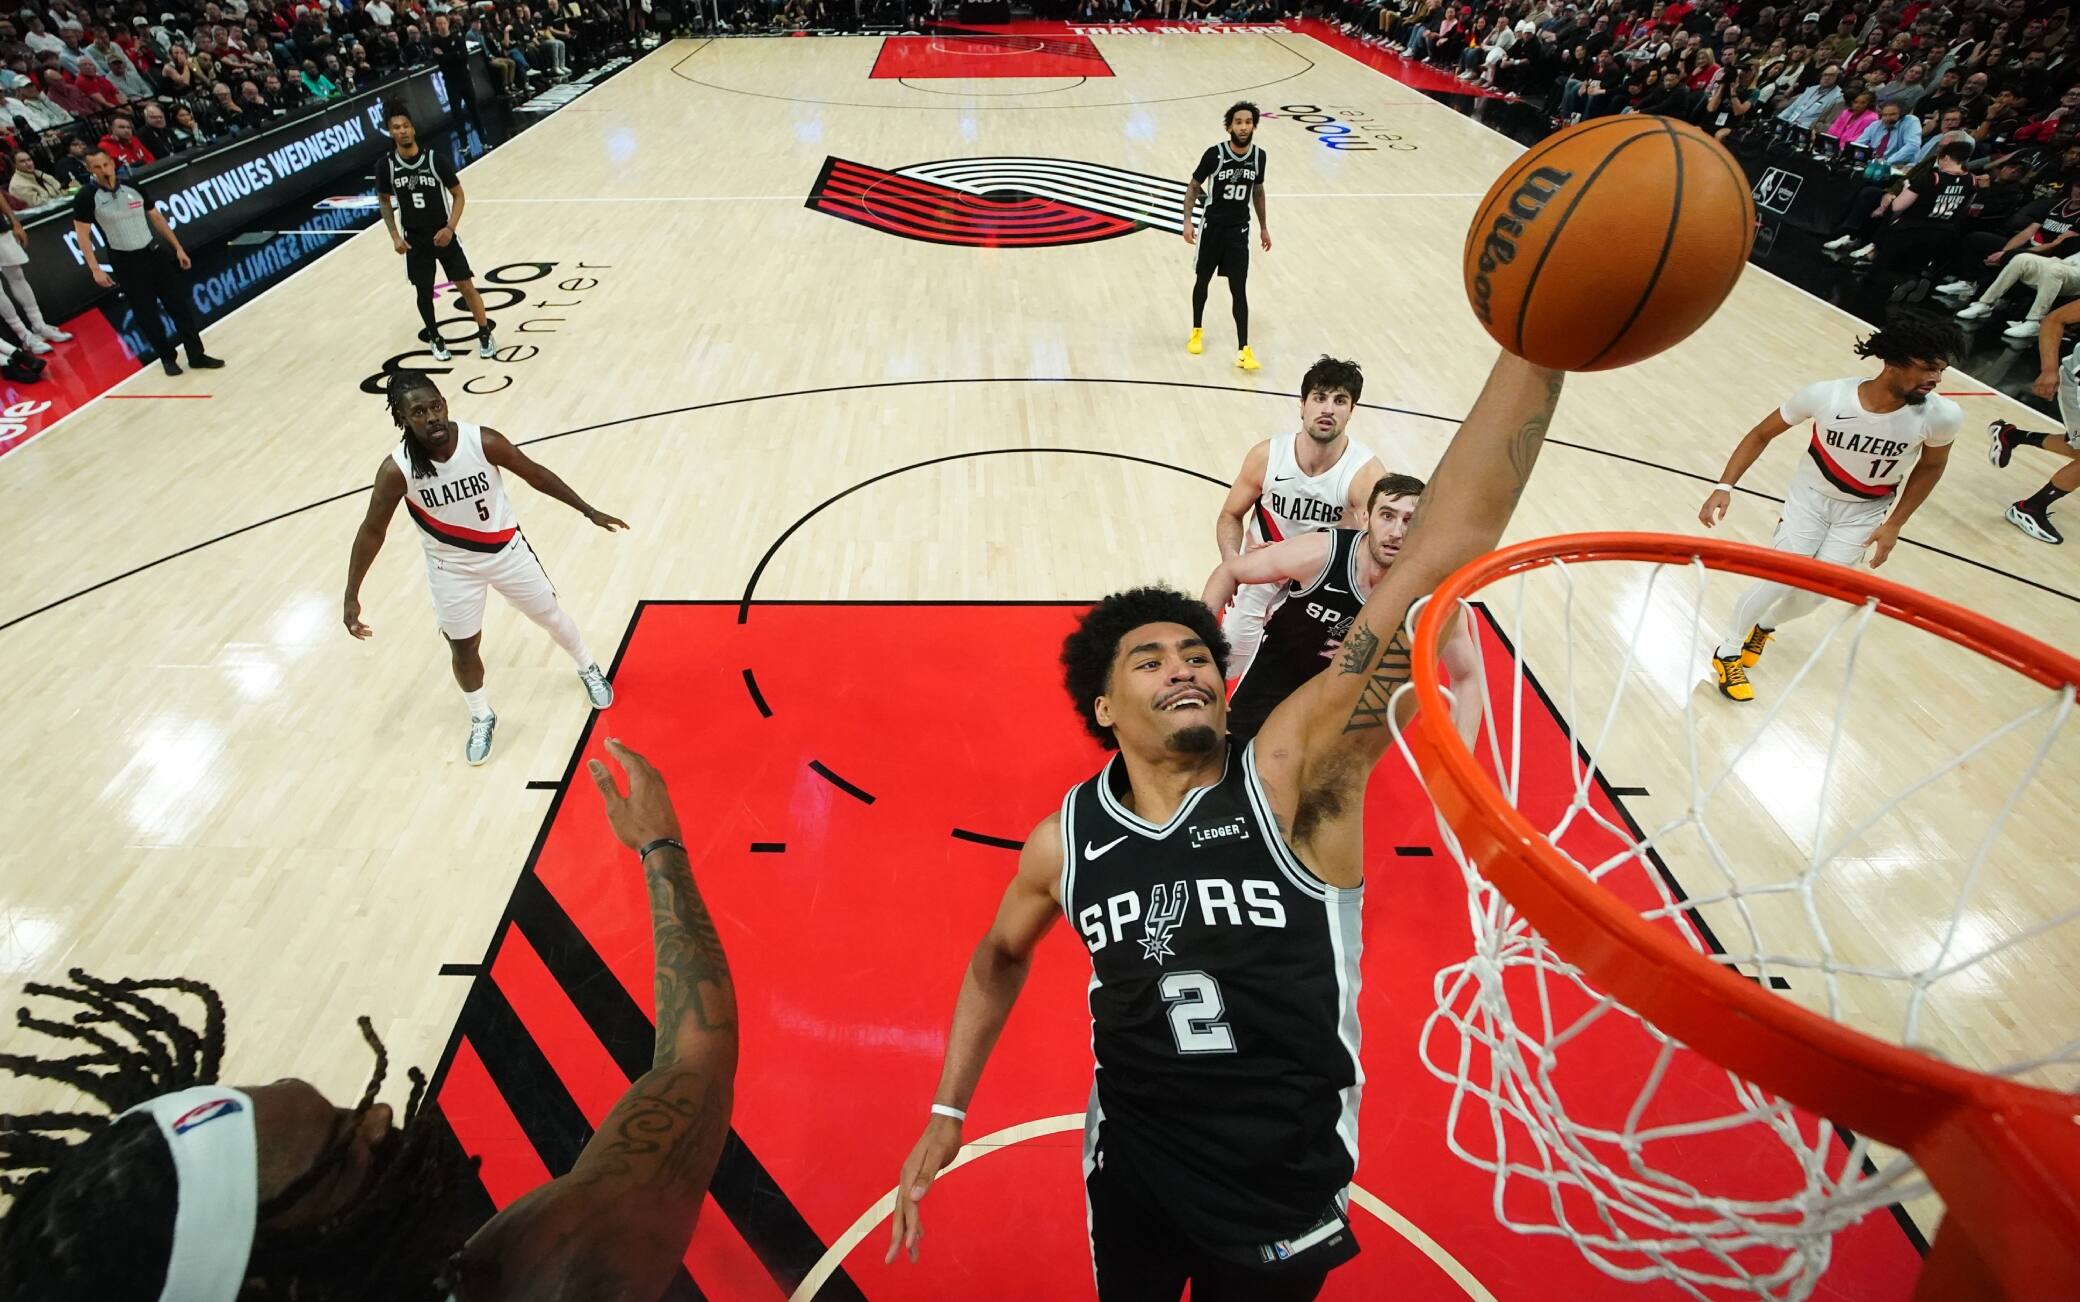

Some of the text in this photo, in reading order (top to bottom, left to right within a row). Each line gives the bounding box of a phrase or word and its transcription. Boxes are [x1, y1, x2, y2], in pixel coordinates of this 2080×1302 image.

[1066, 26, 1293, 35] TRAIL BLAZERS
[154, 115, 366, 231] CONTINUES WEDNESDAY
[412, 193, 426, 209] 5
[1223, 185, 1248, 200] 30
[1473, 166, 1574, 326] Wilson
[462, 262, 612, 395] center
[1826, 428, 1909, 458] BLAZERS
[1868, 459, 1899, 479] 17
[417, 471, 490, 508] BLAZERS
[474, 498, 490, 522] 5
[1271, 492, 1344, 523] BLAZERS
[1196, 824, 1240, 841] LEDGER
[1079, 878, 1287, 966] SPURS
[1157, 970, 1237, 1055] 2
